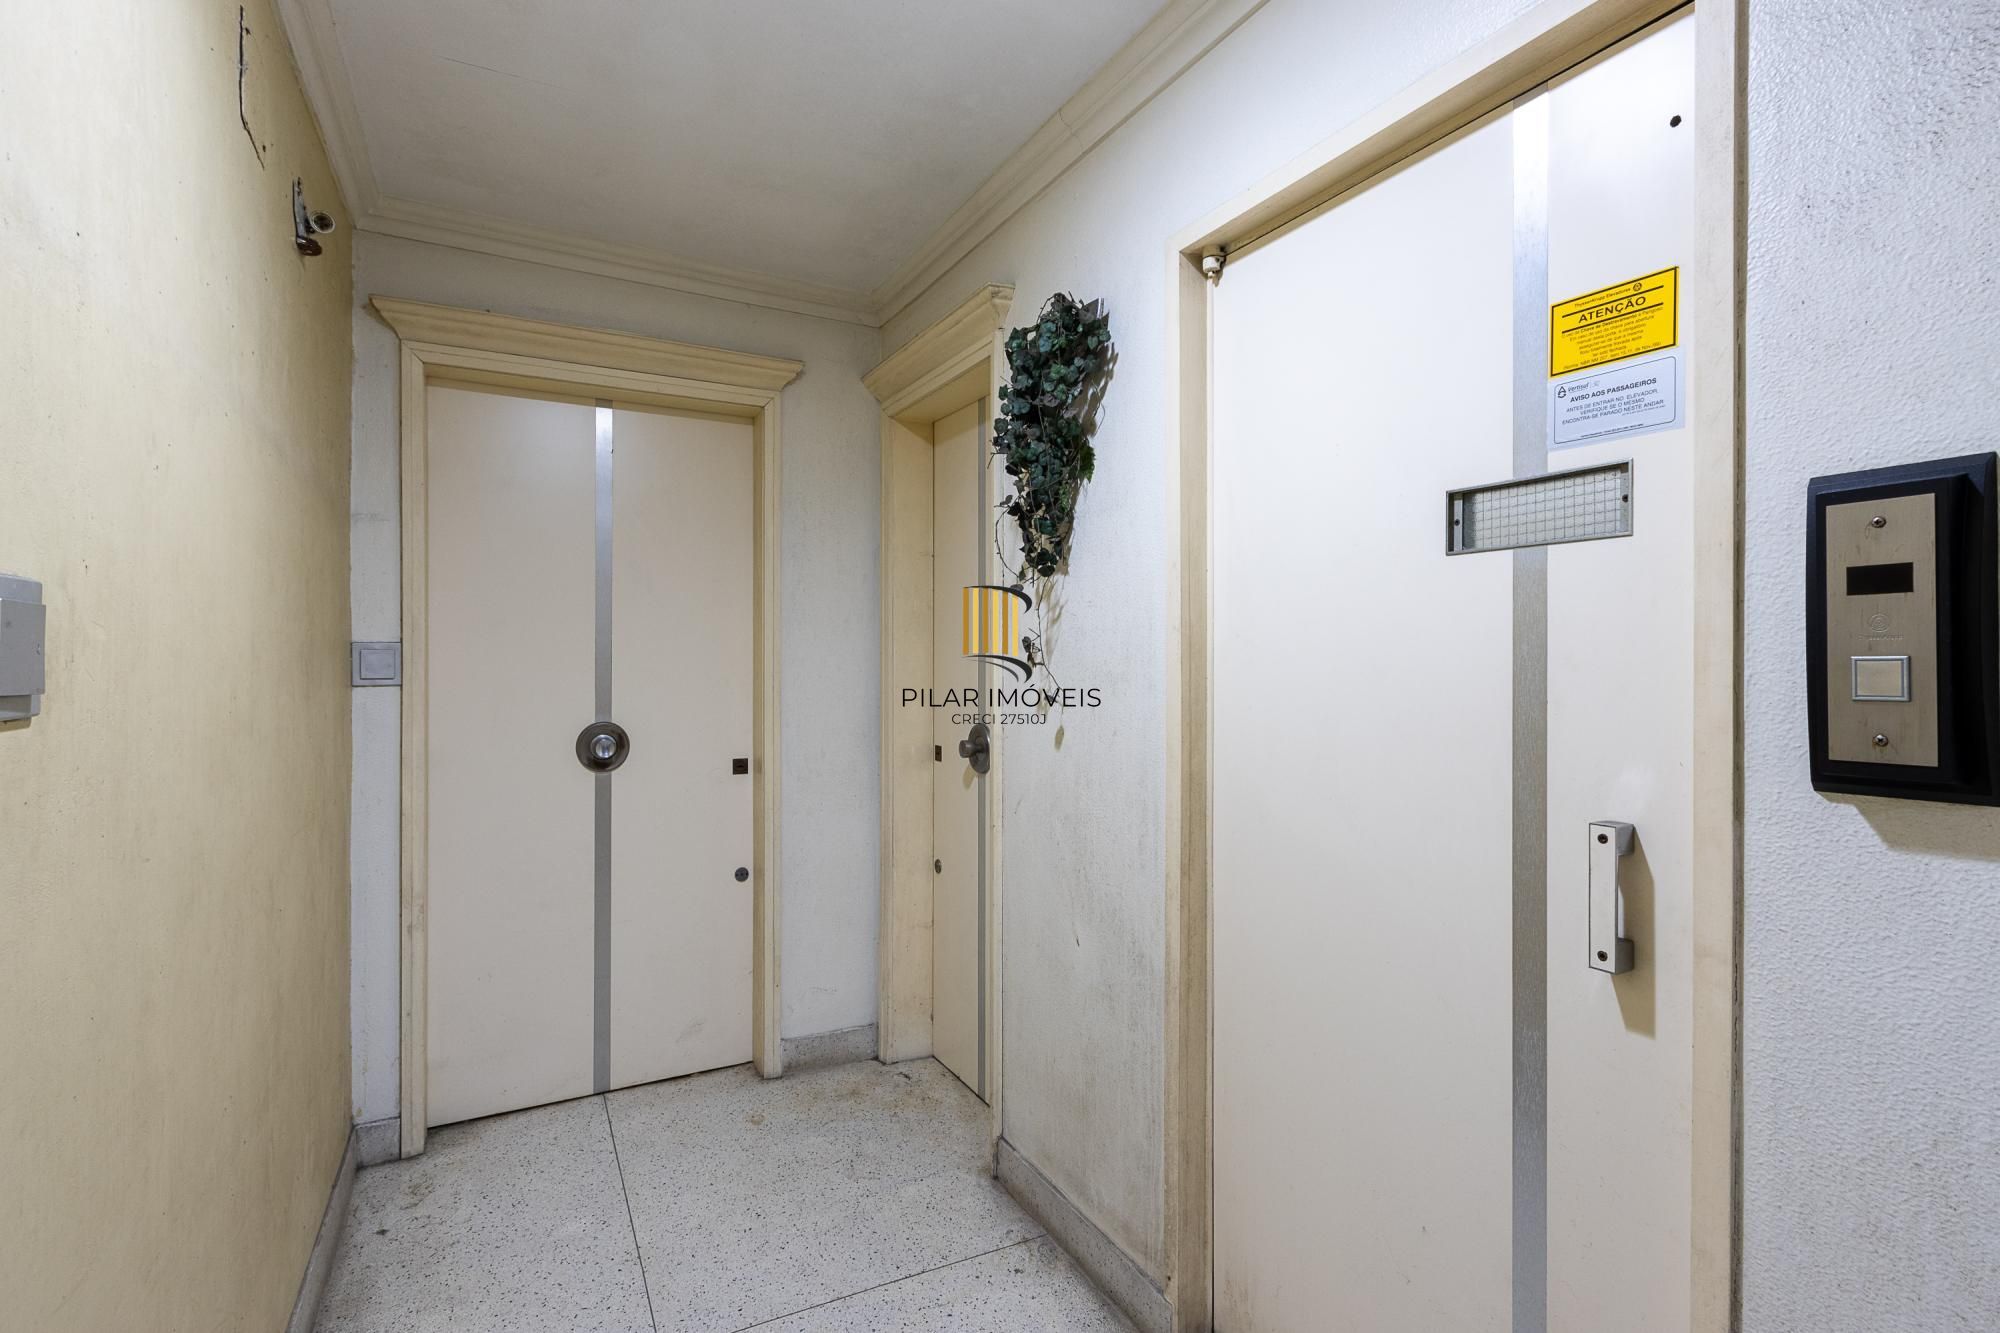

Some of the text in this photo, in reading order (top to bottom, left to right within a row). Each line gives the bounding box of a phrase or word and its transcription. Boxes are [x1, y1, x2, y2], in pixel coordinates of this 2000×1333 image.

[1578, 296, 1646, 323] ATENÇÃO
[1570, 393, 1590, 403] AVISO
[1591, 389, 1606, 398] AOS
[1607, 378, 1657, 394] PASSAGEIROS
[1592, 397, 1615, 407] ENTRAR
